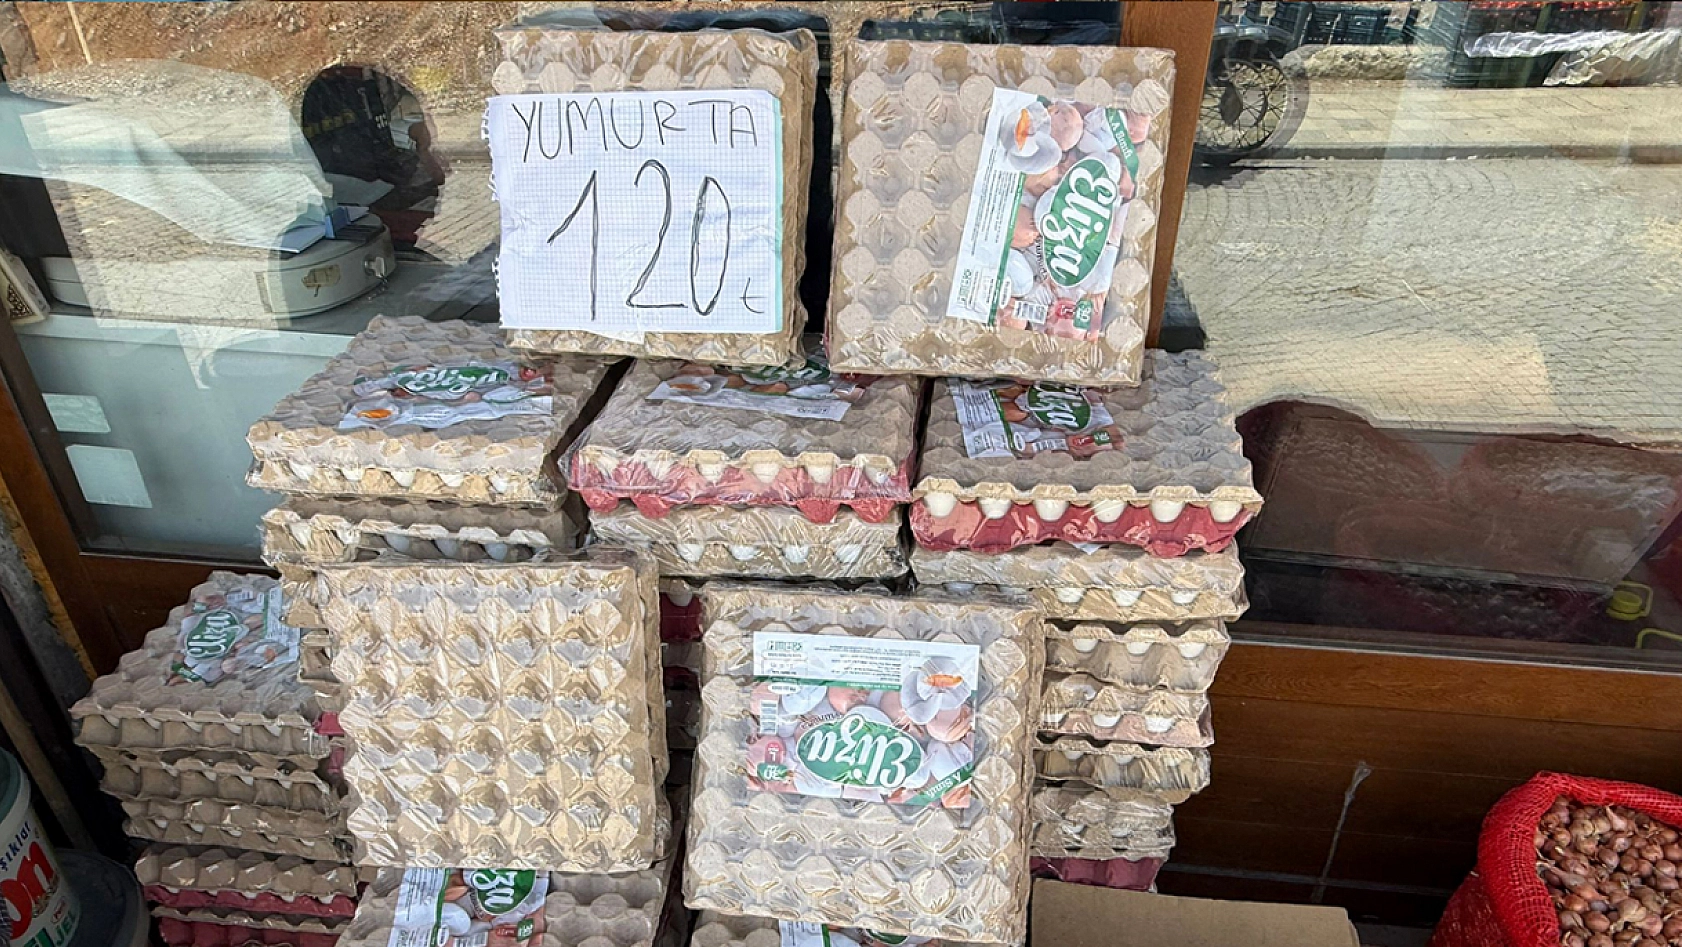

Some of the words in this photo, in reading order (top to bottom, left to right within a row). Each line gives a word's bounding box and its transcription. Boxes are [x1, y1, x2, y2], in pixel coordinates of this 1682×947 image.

[512, 97, 757, 163] YUMURTA
[547, 159, 732, 321] 120
[1043, 166, 1118, 280] Eliza
[406, 368, 497, 394] Eliza
[187, 613, 240, 658] Eliza
[806, 715, 914, 788] Eliza
